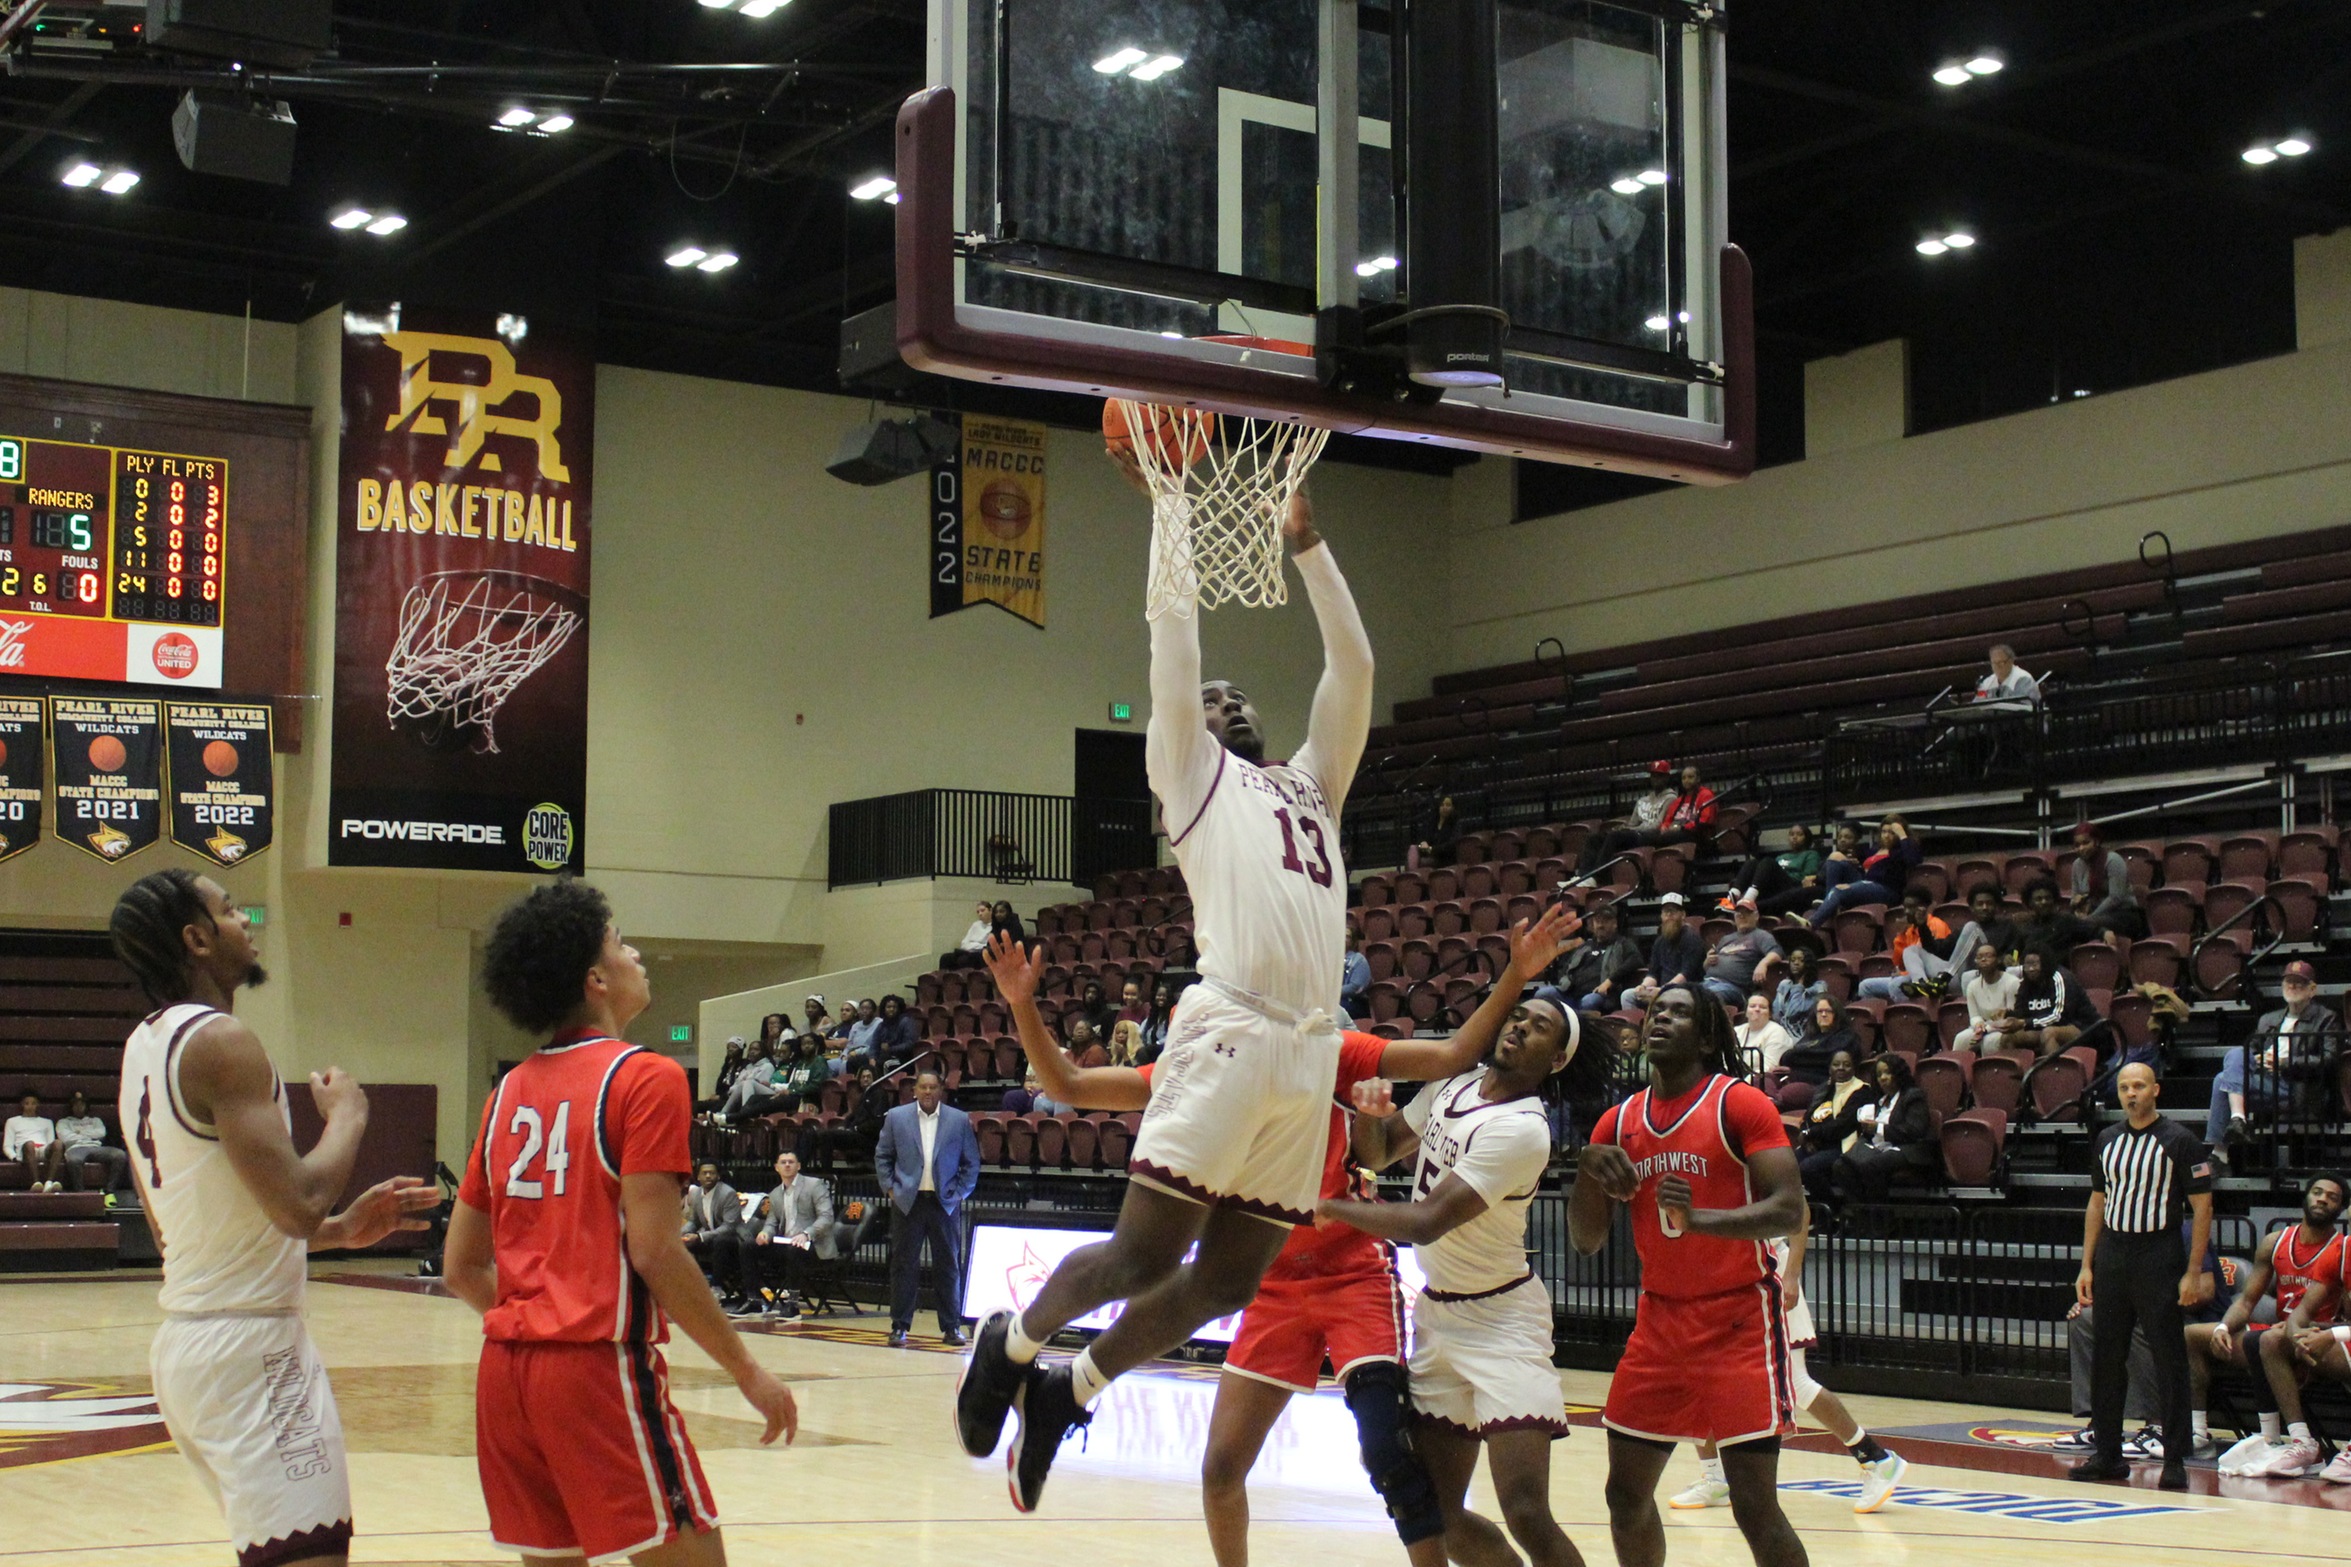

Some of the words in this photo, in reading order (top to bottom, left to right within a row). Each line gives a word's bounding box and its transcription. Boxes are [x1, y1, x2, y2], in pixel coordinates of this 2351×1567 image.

[1446, 353, 1490, 363] porter
[127, 455, 154, 474] PLY
[162, 458, 181, 477] FL
[185, 461, 215, 480] PTS
[966, 447, 1044, 474] MACCC
[28, 487, 94, 510] RANGERS
[135, 478, 149, 499] 0
[170, 481, 184, 502] 0
[207, 485, 219, 506] 3
[134, 501, 148, 521] 2
[169, 504, 183, 525] 0
[205, 507, 219, 529] 2
[357, 477, 577, 552] BASKETBALL
[69, 514, 91, 550] 5
[134, 525, 147, 547] 5
[169, 529, 183, 550] 0
[204, 532, 218, 553] 0
[61, 555, 98, 569] FOULS
[168, 552, 182, 573] 0
[203, 555, 217, 576] 0
[966, 545, 1041, 574] STATE
[33, 573, 47, 595] 6
[79, 573, 98, 603] 0
[118, 572, 146, 593] 24
[167, 576, 181, 598] 0
[203, 580, 216, 601] 0
[965, 571, 1041, 591] CHAMPIONS
[157, 659, 192, 669] UNITED
[55, 700, 105, 714] PEARL
[110, 702, 156, 715] RIVER
[170, 706, 218, 719] PEARL
[221, 708, 265, 721] RIVER
[1114, 703, 1130, 719] EXIT
[74, 723, 140, 734] WILDCATS
[192, 729, 247, 740] WILDCATS
[58, 785, 94, 799] STATE
[96, 787, 159, 800] CHAMPIONS
[89, 774, 128, 787] MACCC
[76, 799, 140, 820] 2021
[180, 792, 212, 804] STATE
[195, 805, 254, 825] 2022
[528, 809, 570, 841] CORE
[341, 819, 504, 845] POWERADE
[526, 839, 569, 864] POWER
[1273, 807, 1332, 889] 13
[671, 1025, 690, 1041] EXIT
[136, 1074, 162, 1188] 4
[505, 1100, 570, 1199] 24
[1634, 1151, 1708, 1182] ORTHWEST
